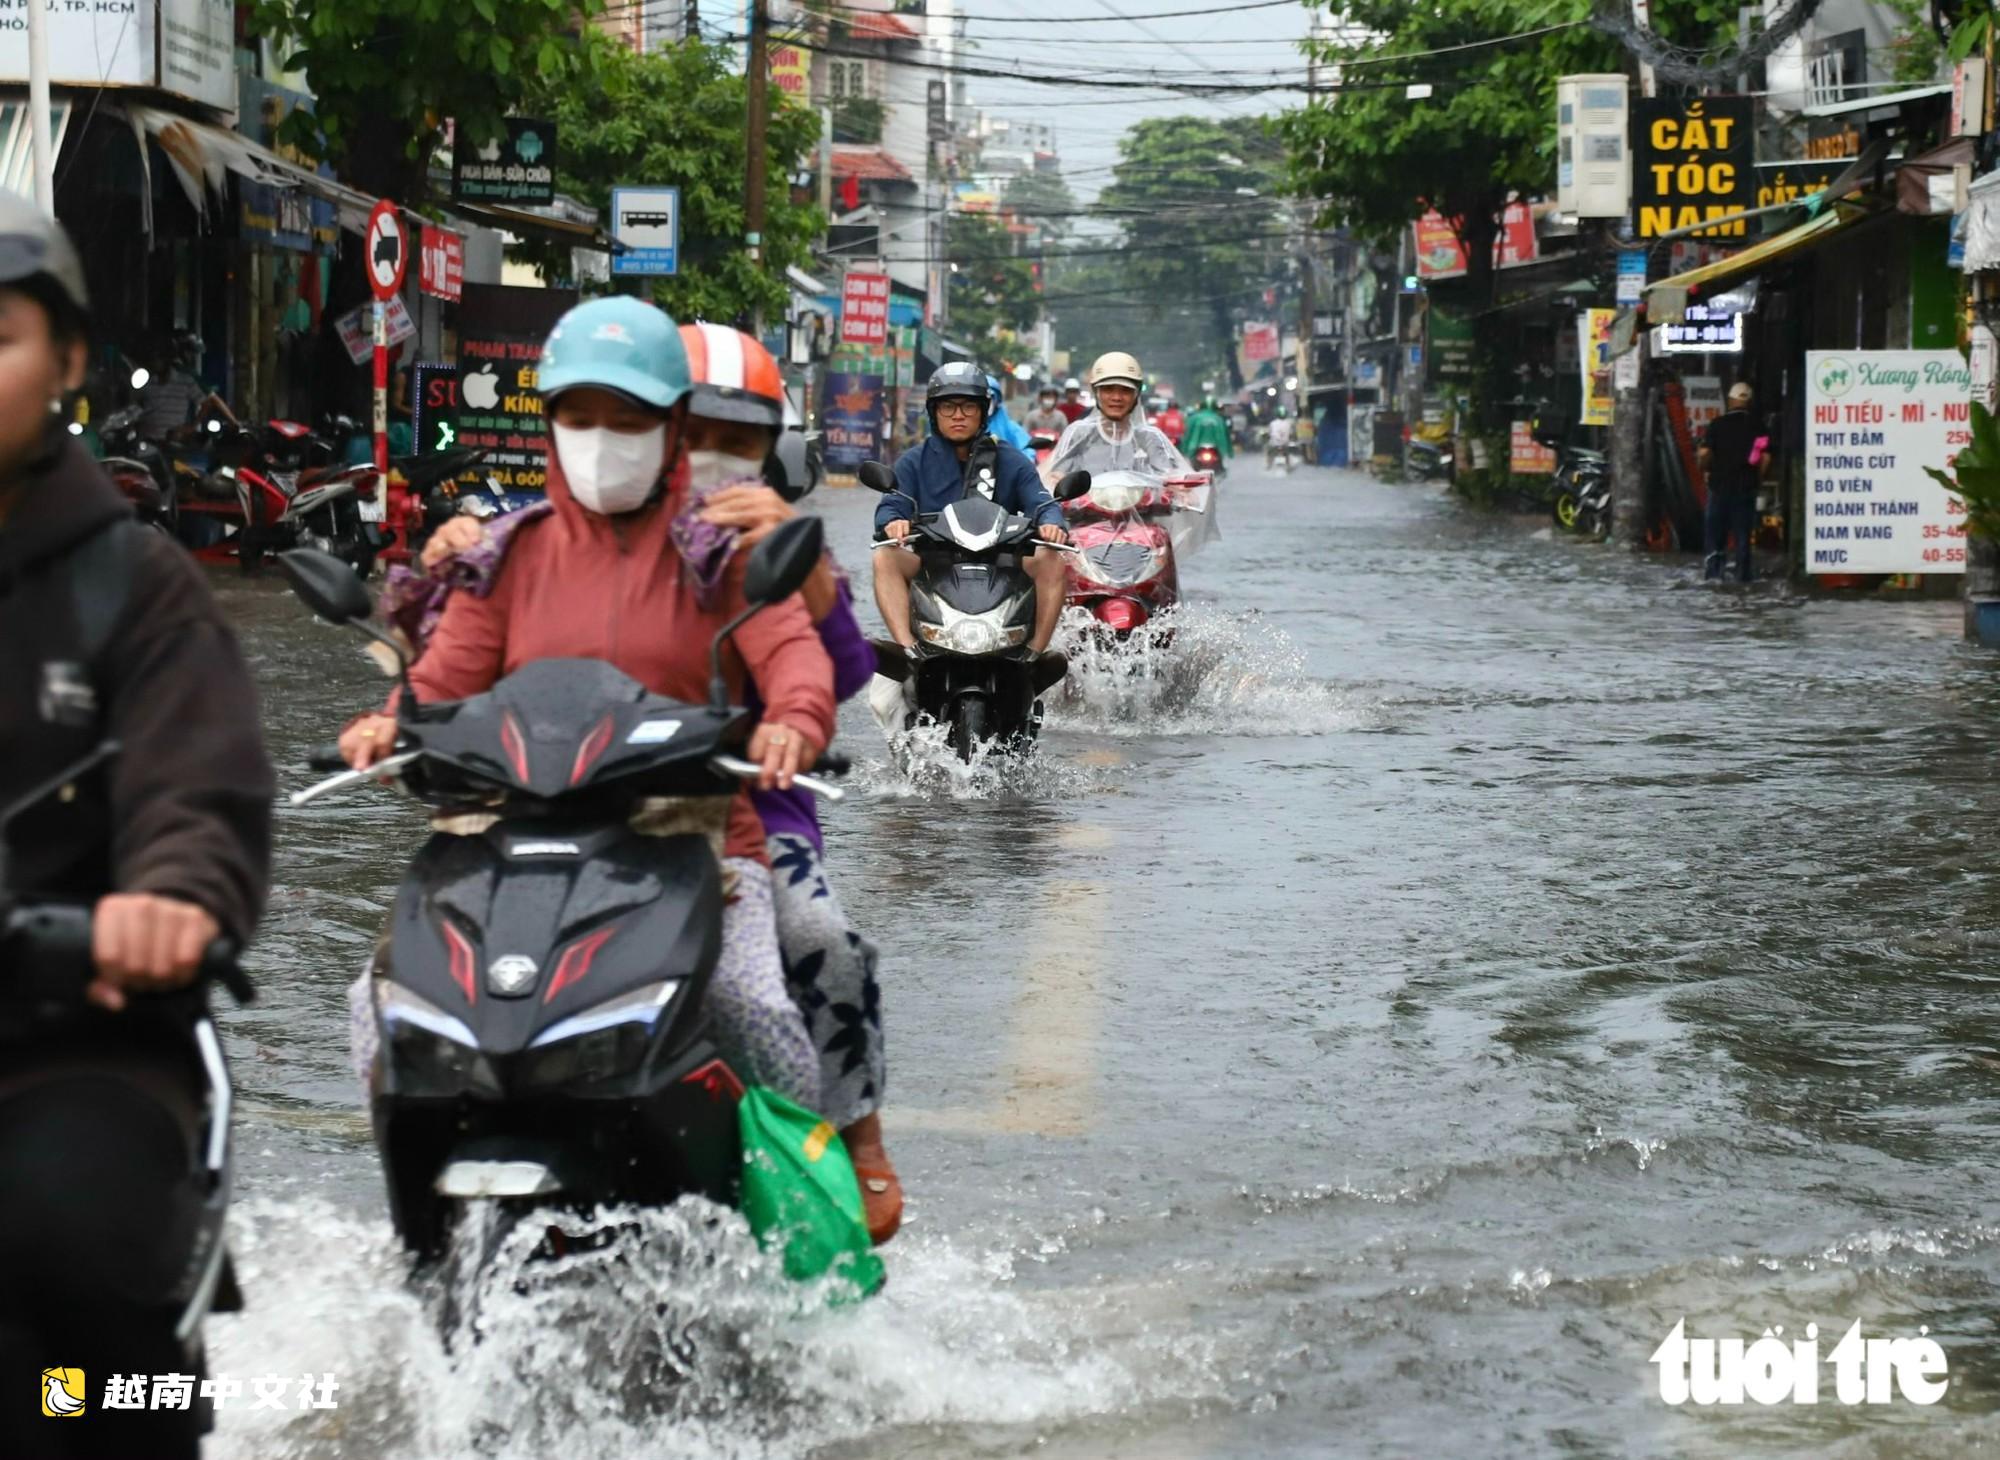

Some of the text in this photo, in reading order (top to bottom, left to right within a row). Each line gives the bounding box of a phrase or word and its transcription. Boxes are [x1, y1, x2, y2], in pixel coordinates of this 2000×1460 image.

[64, 0, 90, 12] TP.
[96, 1, 135, 13] HCM
[1651, 101, 1734, 151] CẮT
[1650, 154, 1735, 195] TÓC
[1640, 204, 1745, 237] NAM
[1814, 399, 1838, 424] HỦ
[1844, 399, 1883, 424] TIẾU
[1815, 432, 1845, 449] THỊT
[1815, 525, 1893, 539] NAM VANG
[1814, 549, 1848, 566] MỰC
[1922, 548, 1968, 562] 40-55
